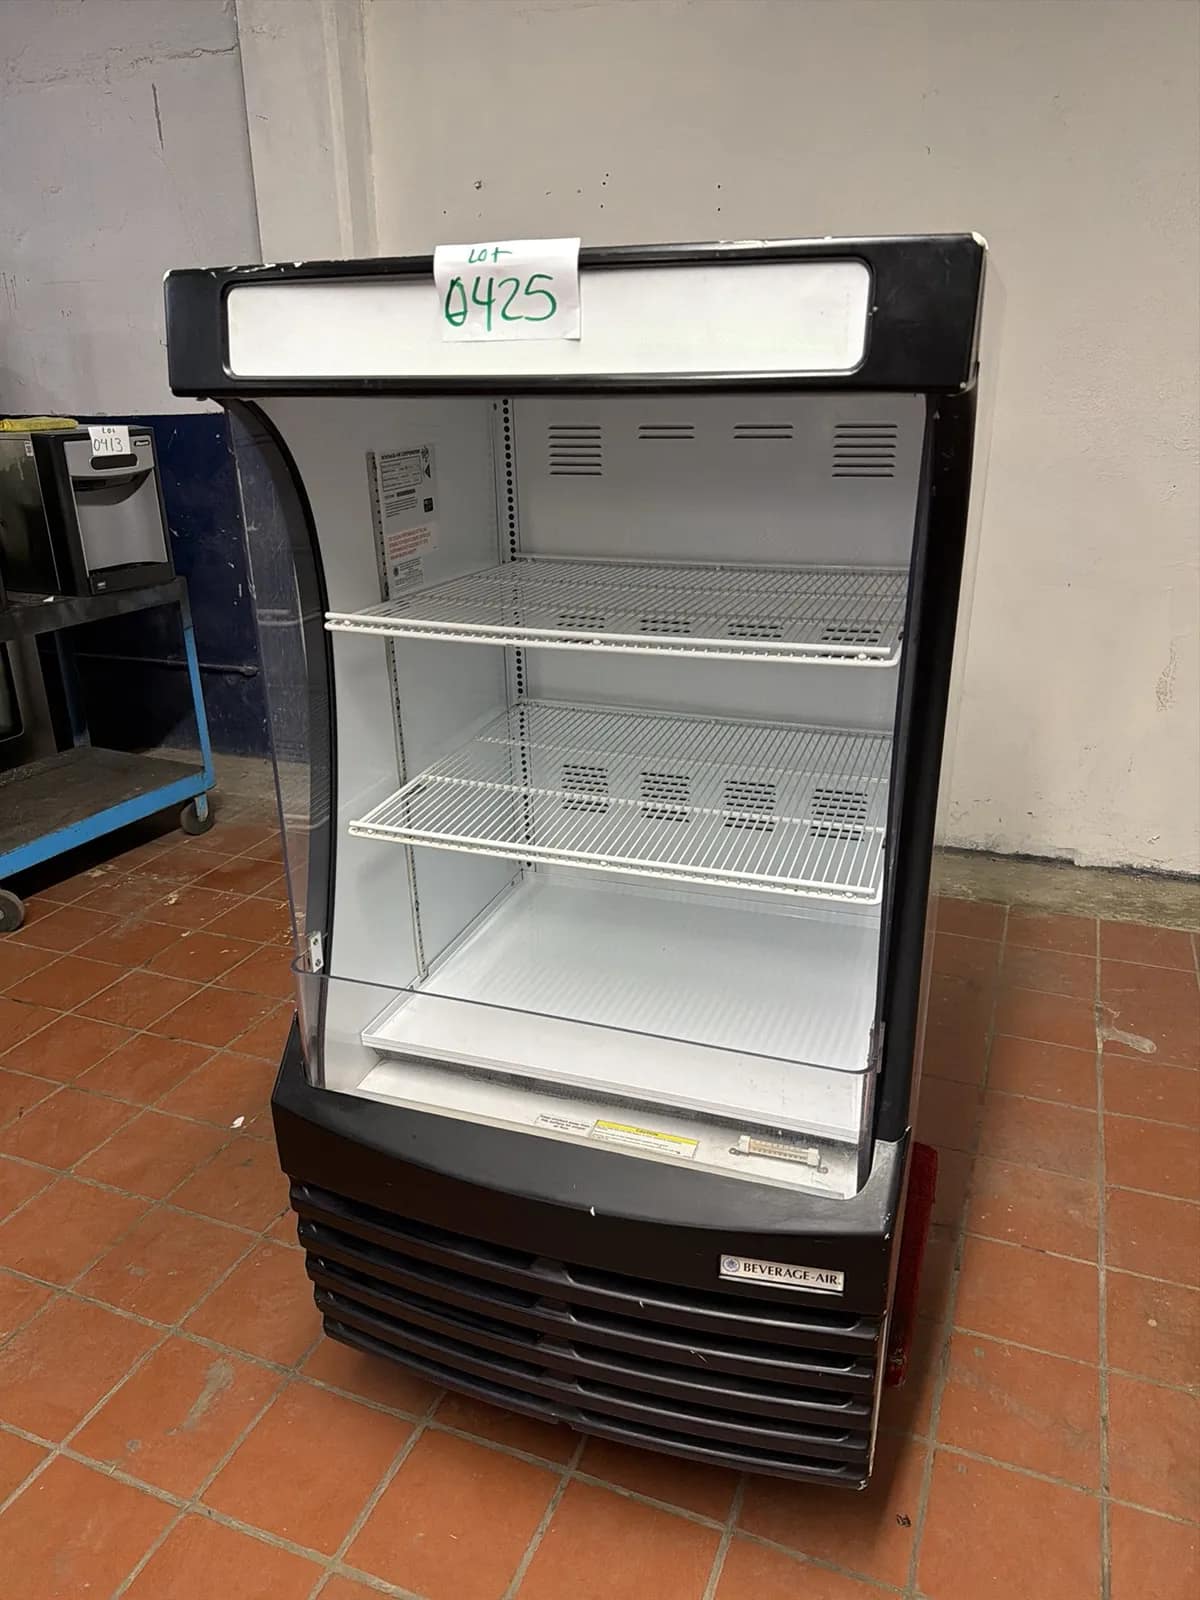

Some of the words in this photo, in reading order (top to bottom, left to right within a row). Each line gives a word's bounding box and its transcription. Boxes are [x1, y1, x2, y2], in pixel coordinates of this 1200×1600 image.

[444, 273, 557, 332] 0425
[93, 437, 123, 453] 0413
[743, 1262, 838, 1286] BEVERAGE-AIR
